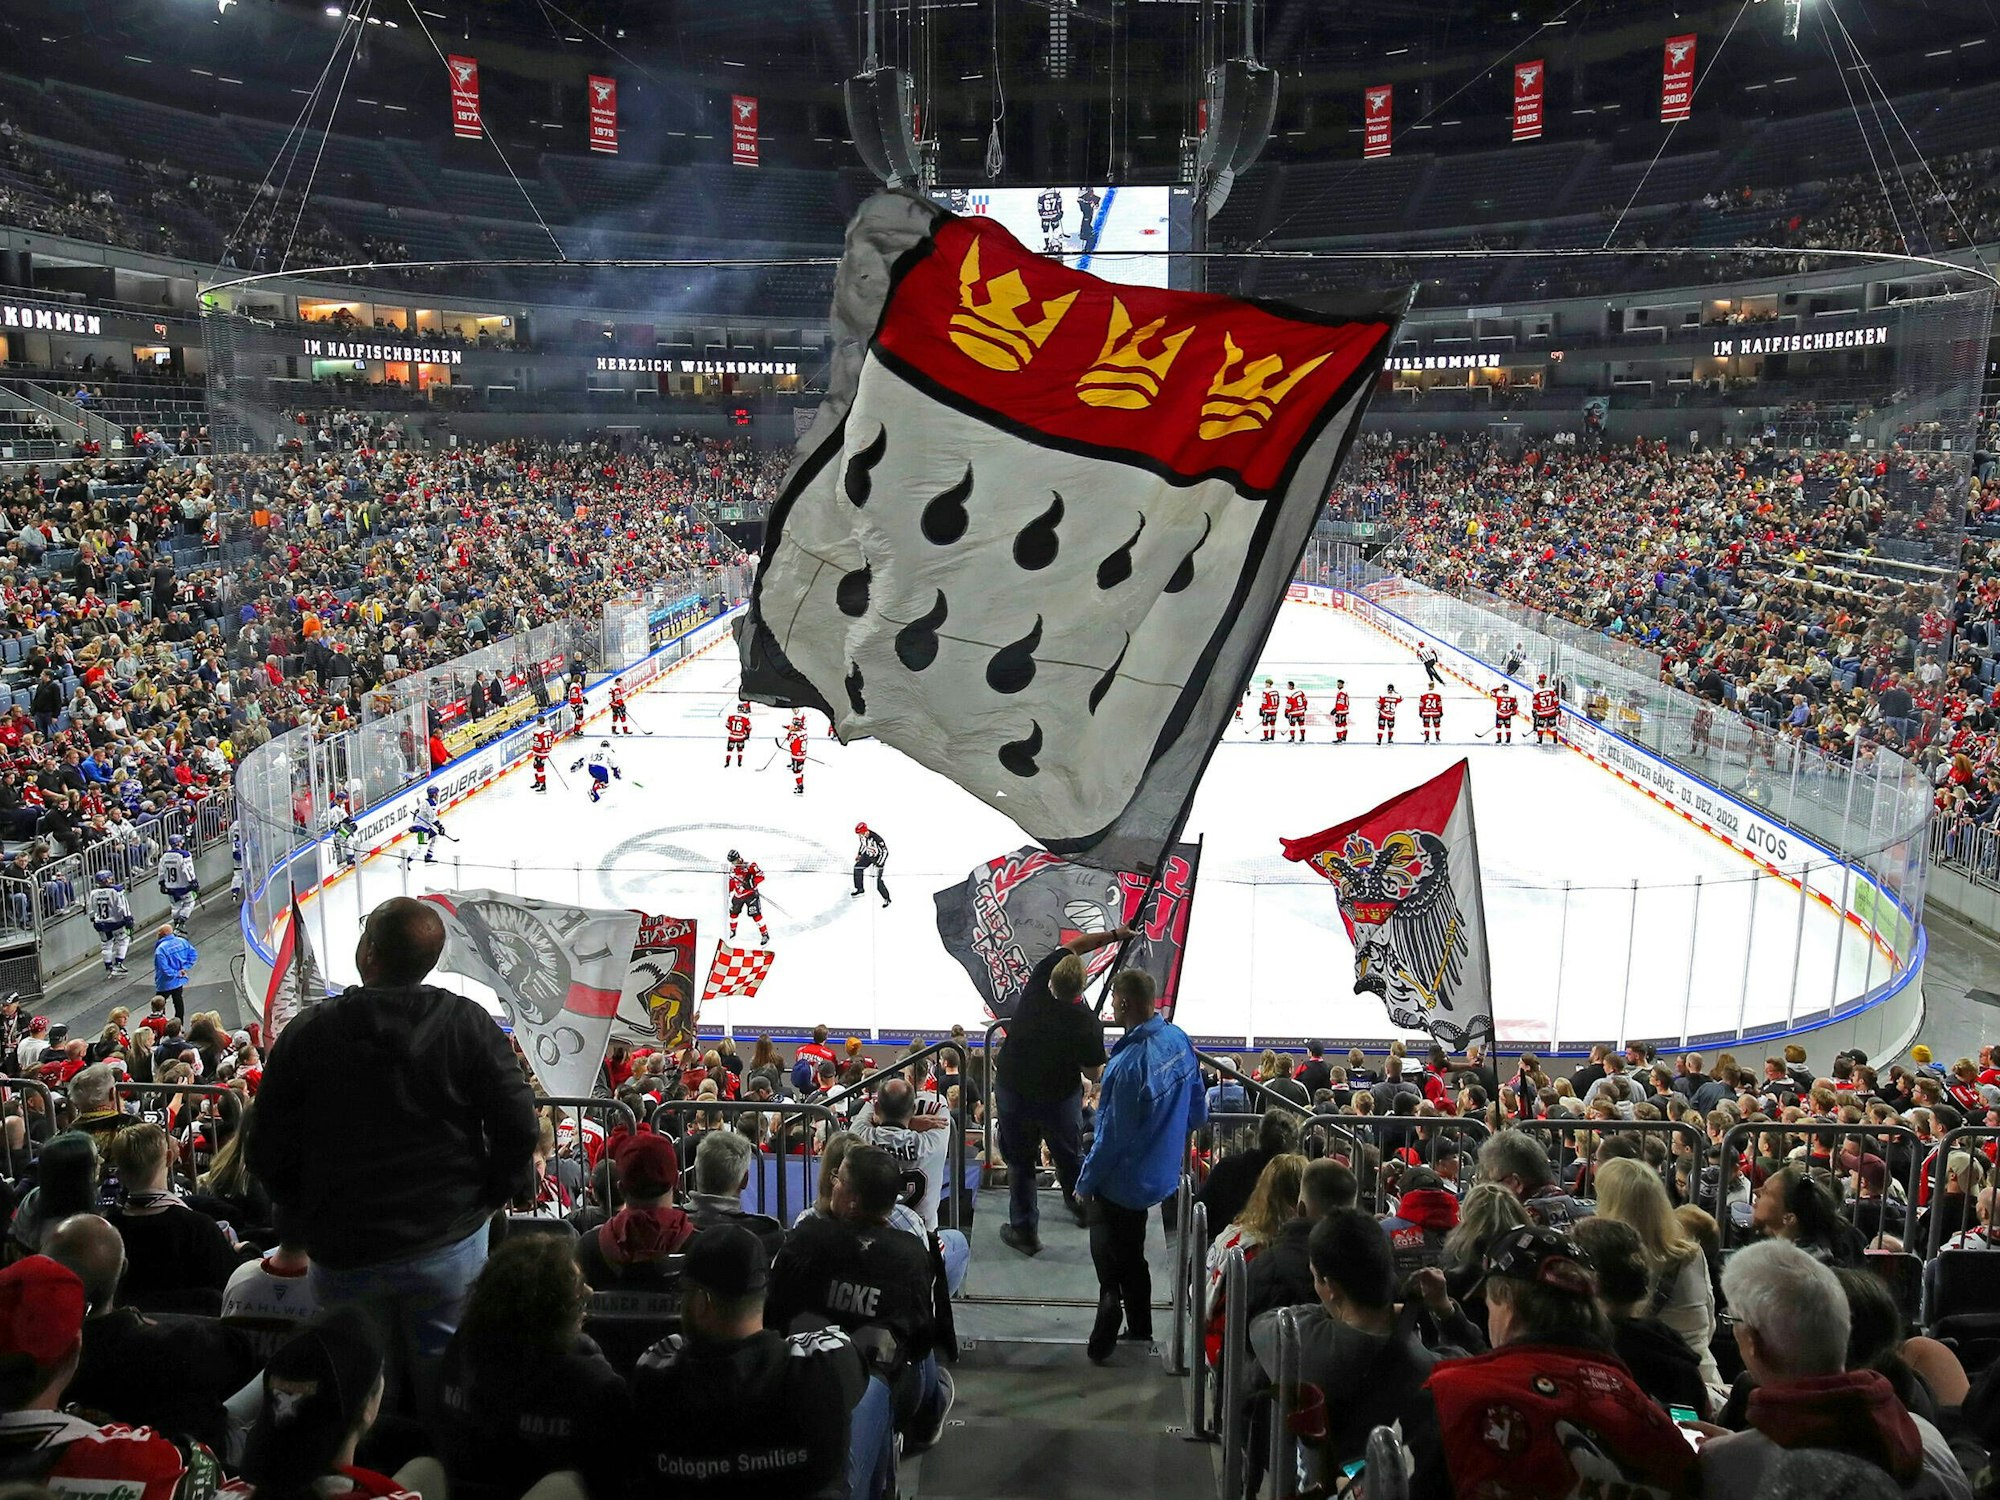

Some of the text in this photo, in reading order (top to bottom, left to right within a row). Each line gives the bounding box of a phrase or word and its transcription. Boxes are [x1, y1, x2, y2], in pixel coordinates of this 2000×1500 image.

[1666, 82, 1687, 90] Meister
[1663, 93, 1687, 104] 2002
[1518, 103, 1538, 111] Meister
[457, 111, 478, 121] 1977
[1517, 113, 1538, 124] 1995
[594, 127, 614, 137] 1979
[1368, 134, 1387, 144] 1988
[736, 142, 755, 152] 1984
[1043, 198, 1057, 211] 67
[0, 306, 101, 335] KOMMEN
[1713, 327, 1887, 356] IM HAIFISCHBECKEN
[304, 339, 463, 364] IM HAIFISCHBECKEN
[597, 357, 797, 375] HERZLICH WILLKOMMEN
[1384, 702, 1396, 712] 39
[1425, 699, 1437, 708] 24
[1539, 695, 1552, 707] 57
[731, 720, 743, 732] 16
[1623, 753, 1651, 781] WINTER
[1653, 771, 1676, 794] GAME
[1681, 789, 1693, 806] 03.
[1696, 795, 1714, 818] DEZ.
[1716, 807, 1739, 832] 2022
[1746, 823, 1788, 860] ATOS
[167, 867, 177, 883] 19
[97, 902, 108, 920] 13
[826, 1279, 881, 1318] ICKE
[657, 1449, 808, 1479] Cologne Smilies
